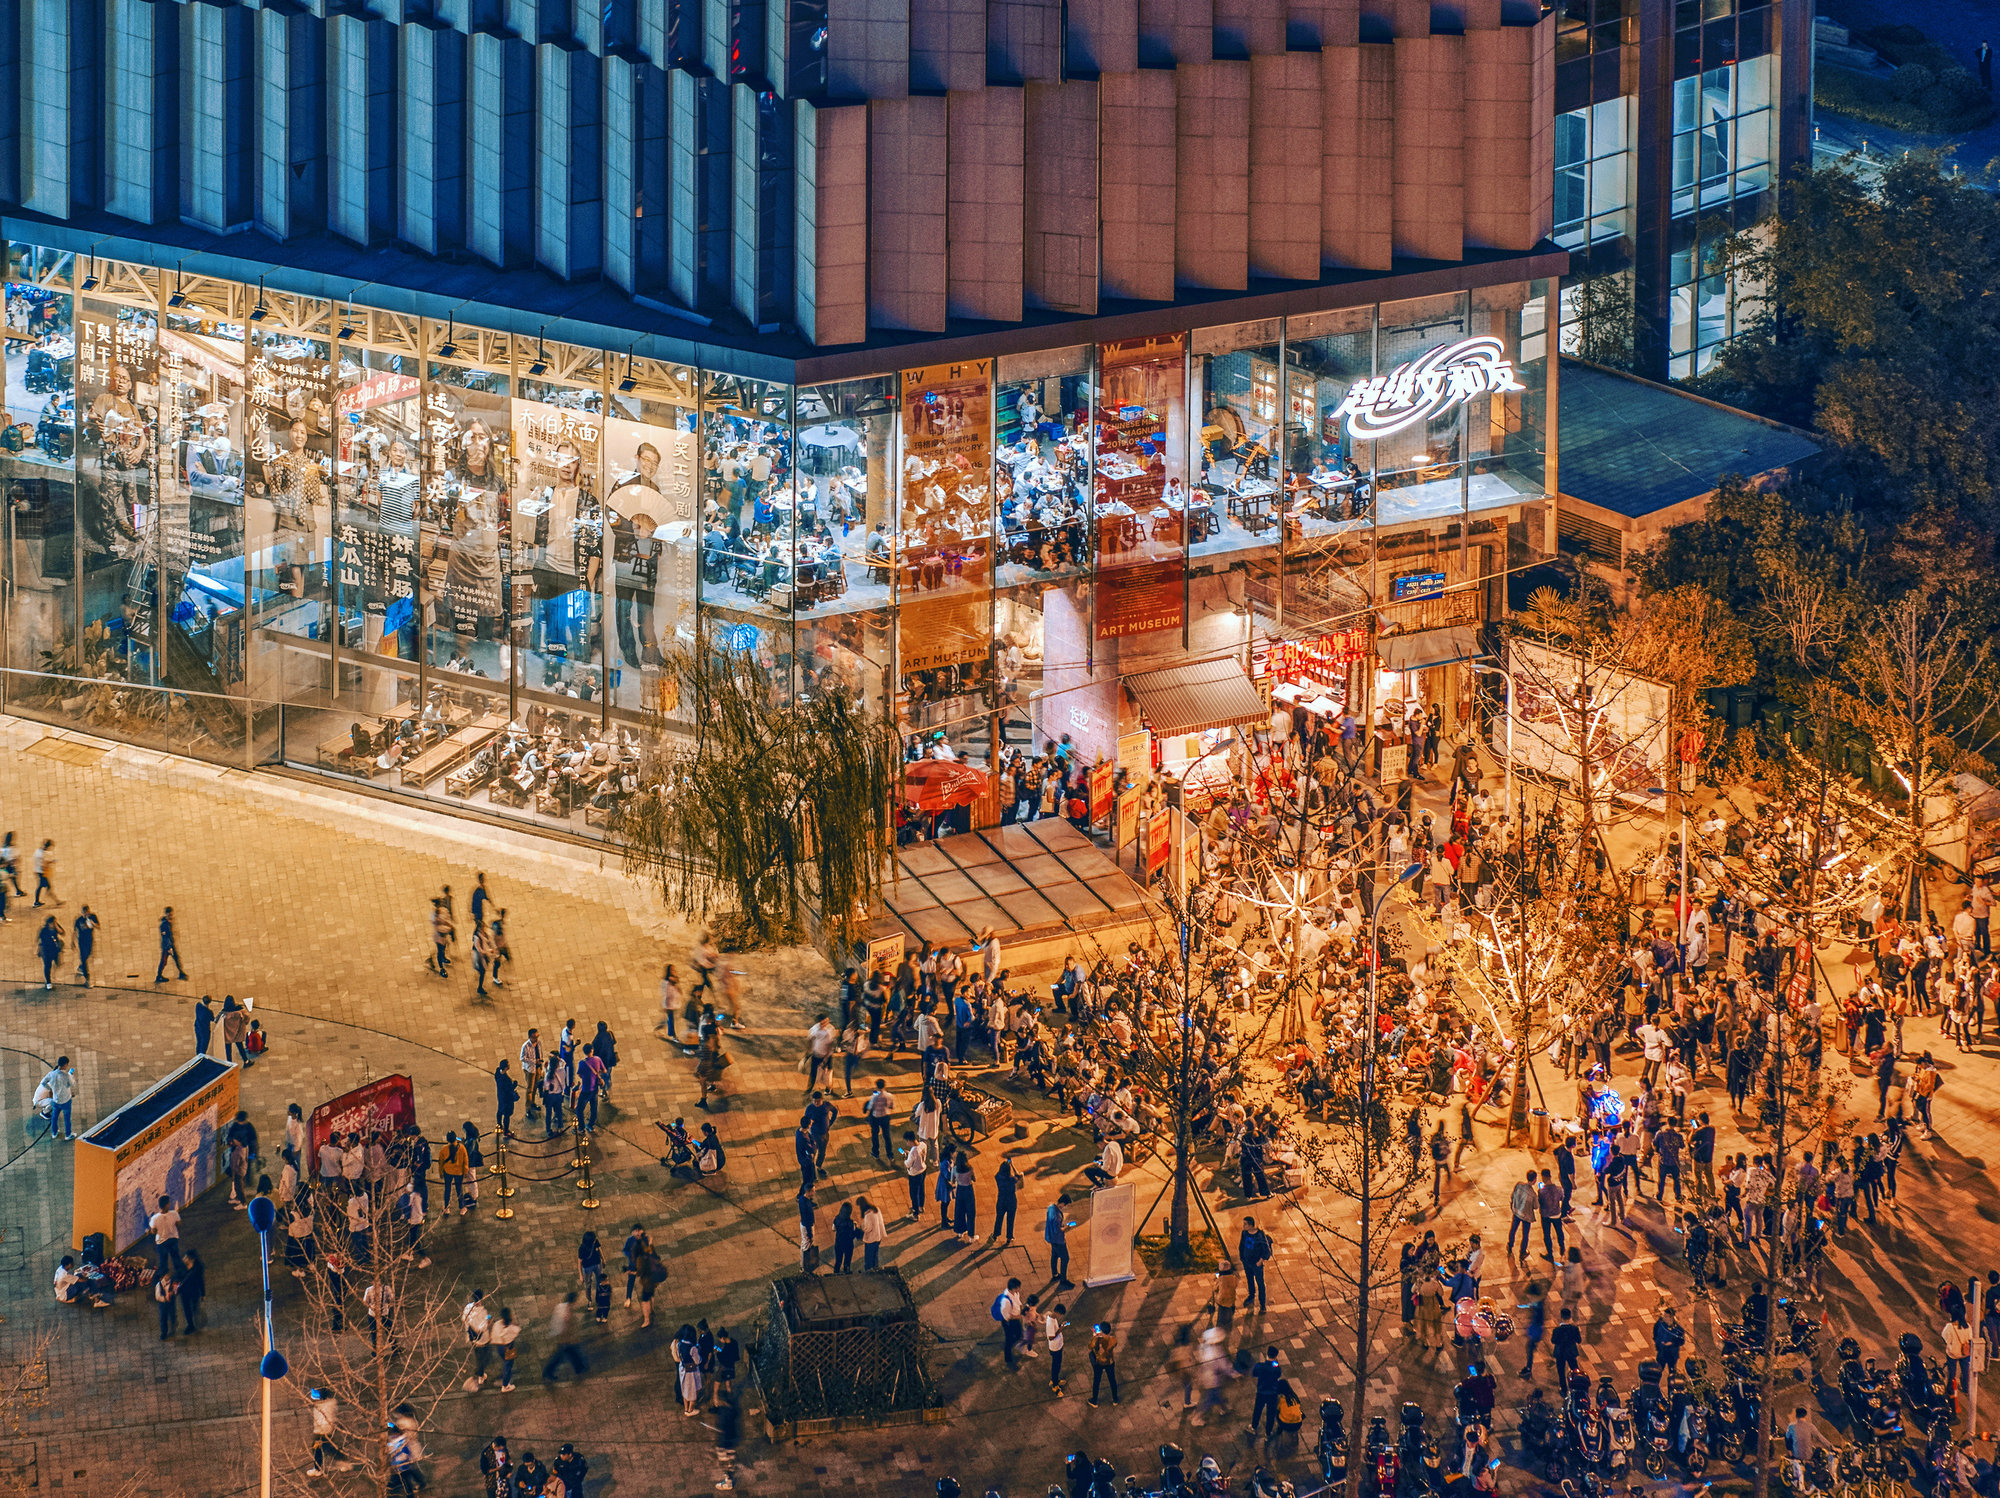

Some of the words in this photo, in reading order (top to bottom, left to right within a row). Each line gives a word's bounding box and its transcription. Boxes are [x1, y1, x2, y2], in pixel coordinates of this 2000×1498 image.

[79, 320, 95, 385] 下岗牌
[97, 323, 112, 386] 臭干子
[169, 351, 183, 437] 正哥牛肉串
[250, 356, 271, 461] 茶颜悦色
[1329, 336, 1527, 440] 超级文和友
[520, 408, 598, 443] 乔伯凉面
[339, 525, 363, 587] 东瓜山
[390, 534, 415, 599] 炸香肠
[1100, 624, 1124, 637] ART
[1128, 615, 1180, 632] MUSEUM
[1265, 629, 1365, 669] 文和友小集市
[904, 656, 929, 669] ART
[933, 647, 987, 664] MUSEUM
[1069, 705, 1089, 725] 长沙
[168, 1102, 195, 1128] 文明礼让
